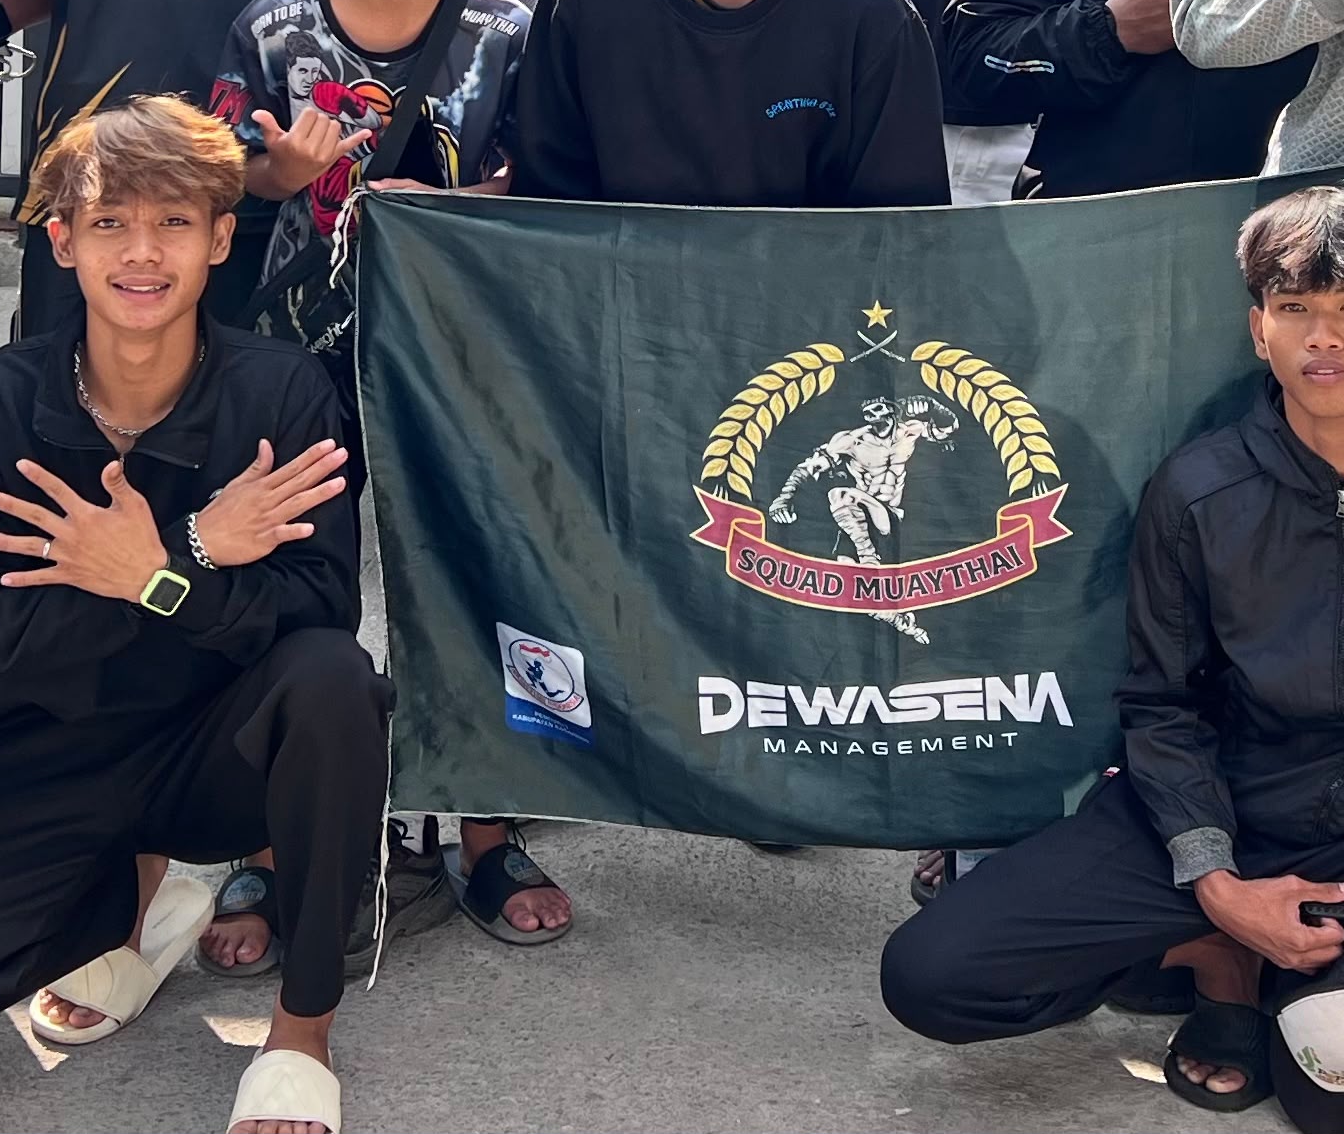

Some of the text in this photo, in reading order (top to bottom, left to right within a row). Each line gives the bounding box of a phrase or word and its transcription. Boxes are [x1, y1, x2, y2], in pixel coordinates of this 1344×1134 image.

[273, 5, 288, 23] TO
[288, 1, 304, 18] BE
[460, 7, 521, 37] MUAY THAI
[735, 543, 1025, 602] SQUAD MUAYTHAI
[697, 671, 1075, 735] DEWASENA
[762, 731, 1019, 756] MANAGEMENT
